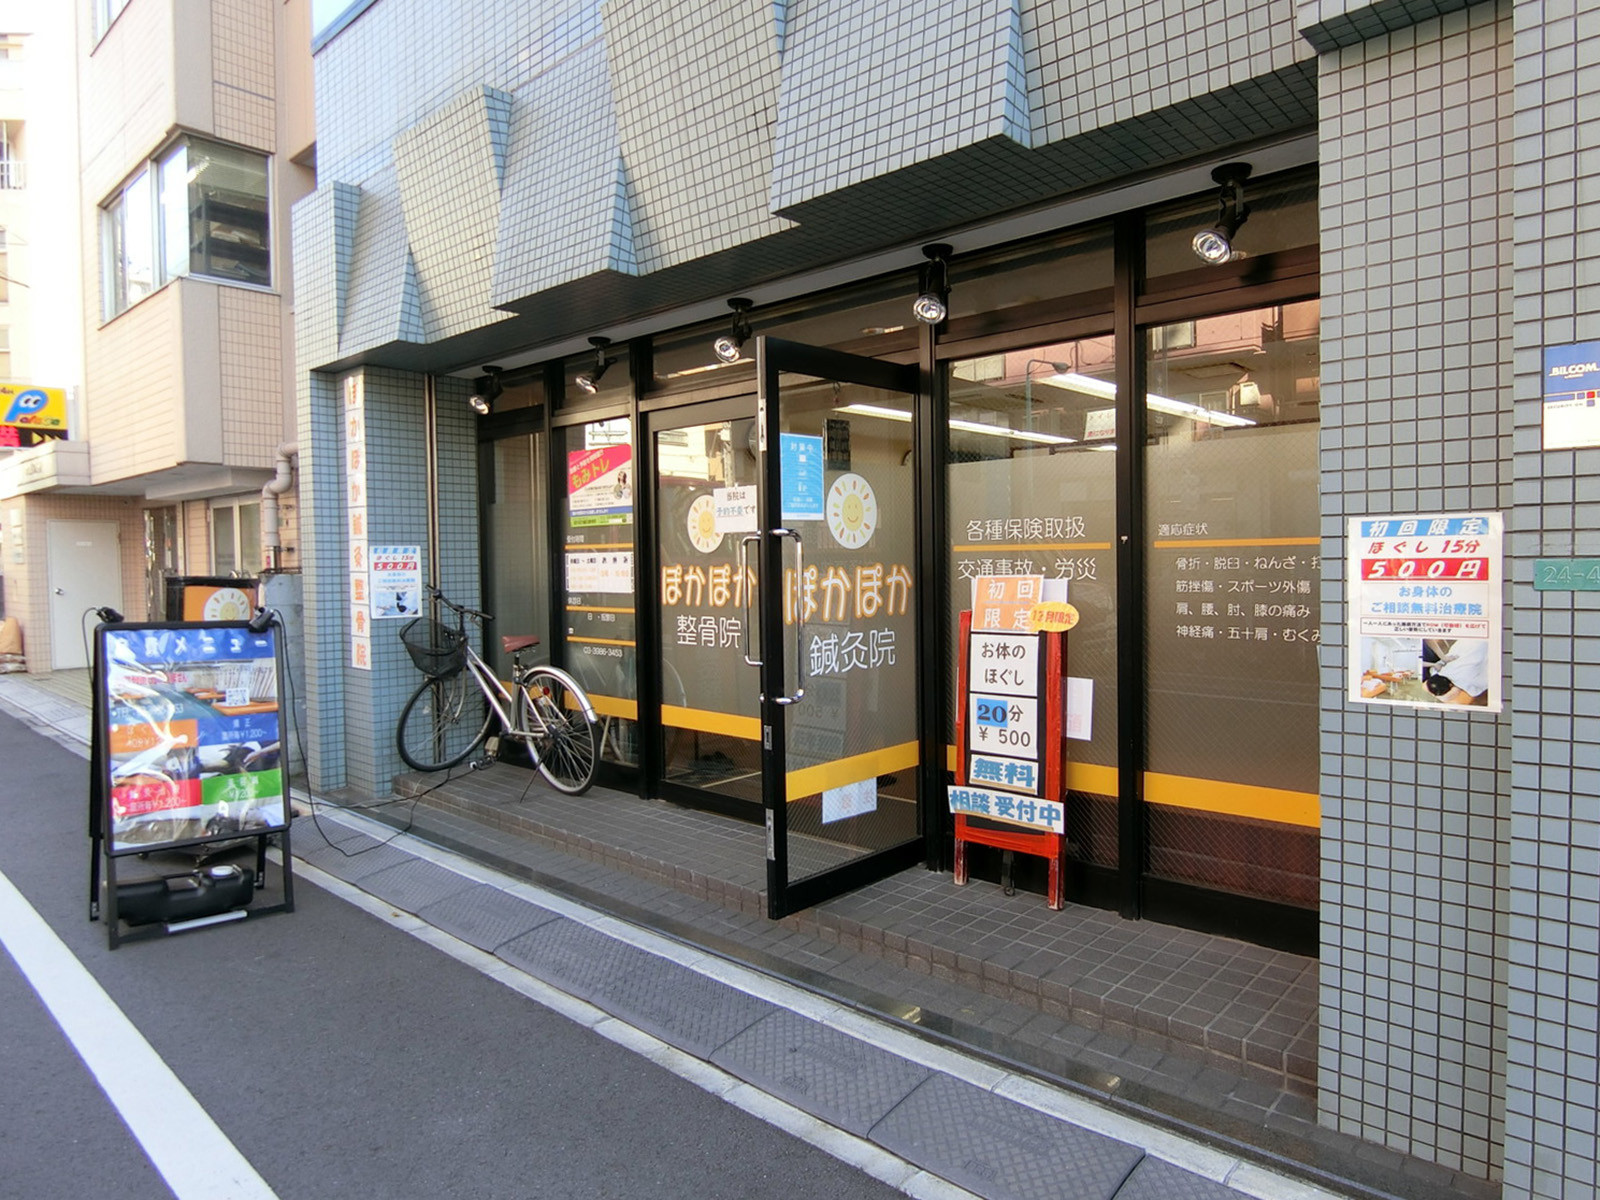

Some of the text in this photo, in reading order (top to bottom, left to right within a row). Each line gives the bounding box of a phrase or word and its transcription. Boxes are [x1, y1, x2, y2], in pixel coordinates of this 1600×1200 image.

[966, 516, 1086, 541] 各種保険取扱
[1158, 523, 1208, 536] 適応症状
[1369, 517, 1484, 537] 初回限定
[957, 557, 1097, 581] 交通事故・労災
[1368, 559, 1482, 578] 500円
[661, 563, 758, 608] ぽかぽか
[784, 563, 913, 625] ぽかぽか
[988, 579, 1034, 600] 初回
[1399, 585, 1453, 598] お身体の
[984, 608, 1032, 629] 限定
[1371, 601, 1483, 616] ご相談無料治療院
[676, 614, 741, 648] 整骨院
[809, 627, 896, 676] 鍼灸院
[981, 642, 1026, 659] お体の
[984, 668, 1025, 686] ほぐし
[976, 704, 1024, 723] 20分
[998, 728, 1031, 747] 500
[973, 757, 1035, 787] 無料
[949, 789, 1061, 826] 相談受付中
